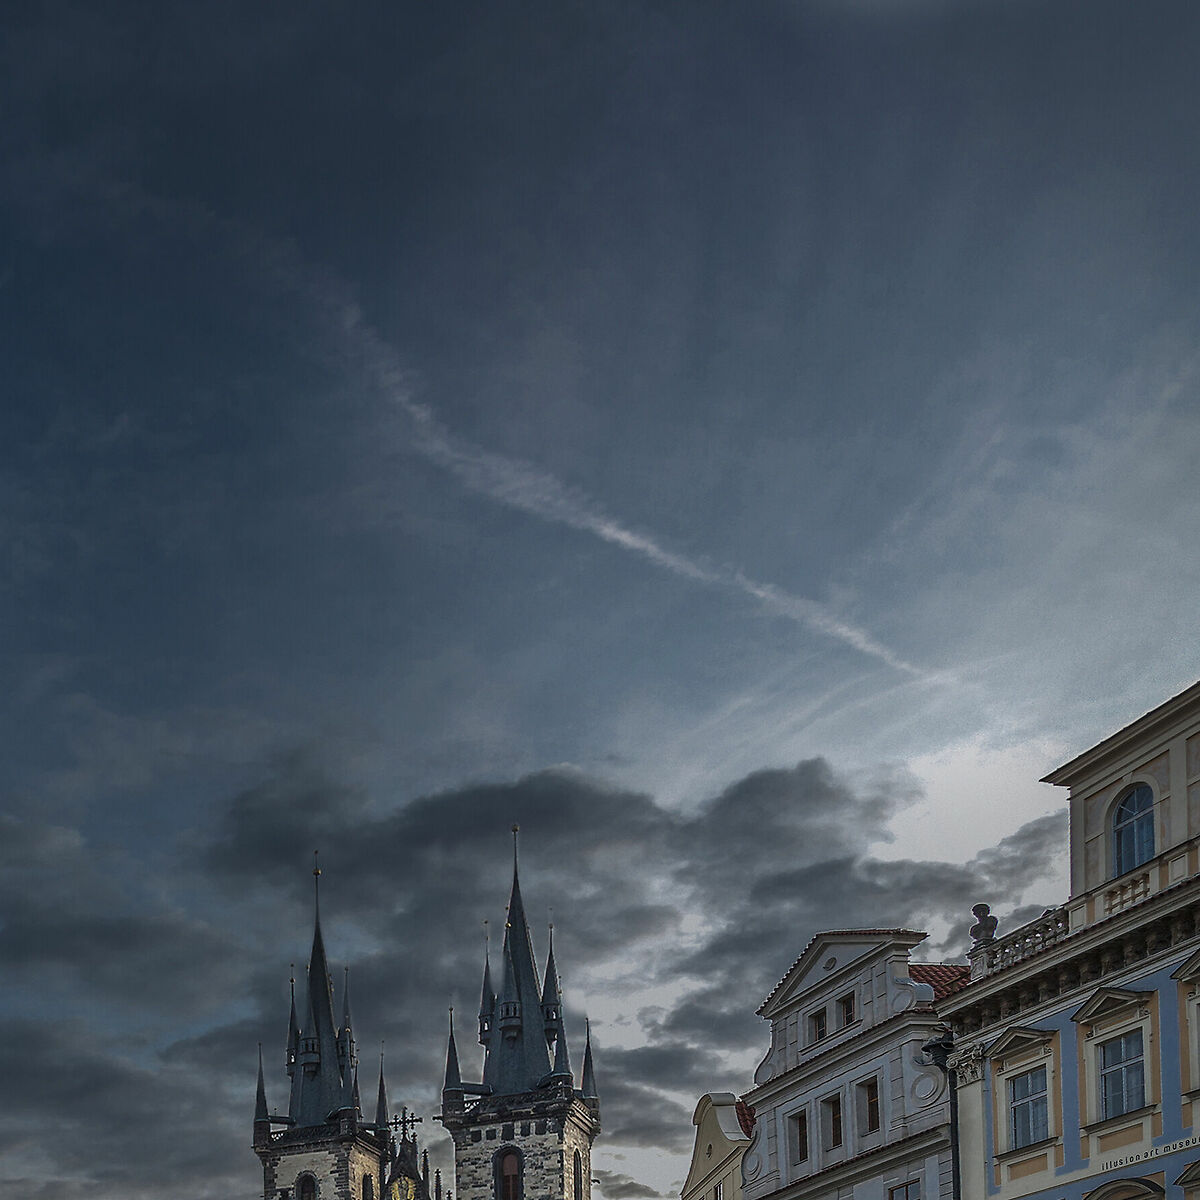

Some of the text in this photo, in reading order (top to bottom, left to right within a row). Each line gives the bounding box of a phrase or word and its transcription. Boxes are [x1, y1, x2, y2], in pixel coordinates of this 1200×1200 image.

[1102, 1136, 1200, 1170] illusion art museu
